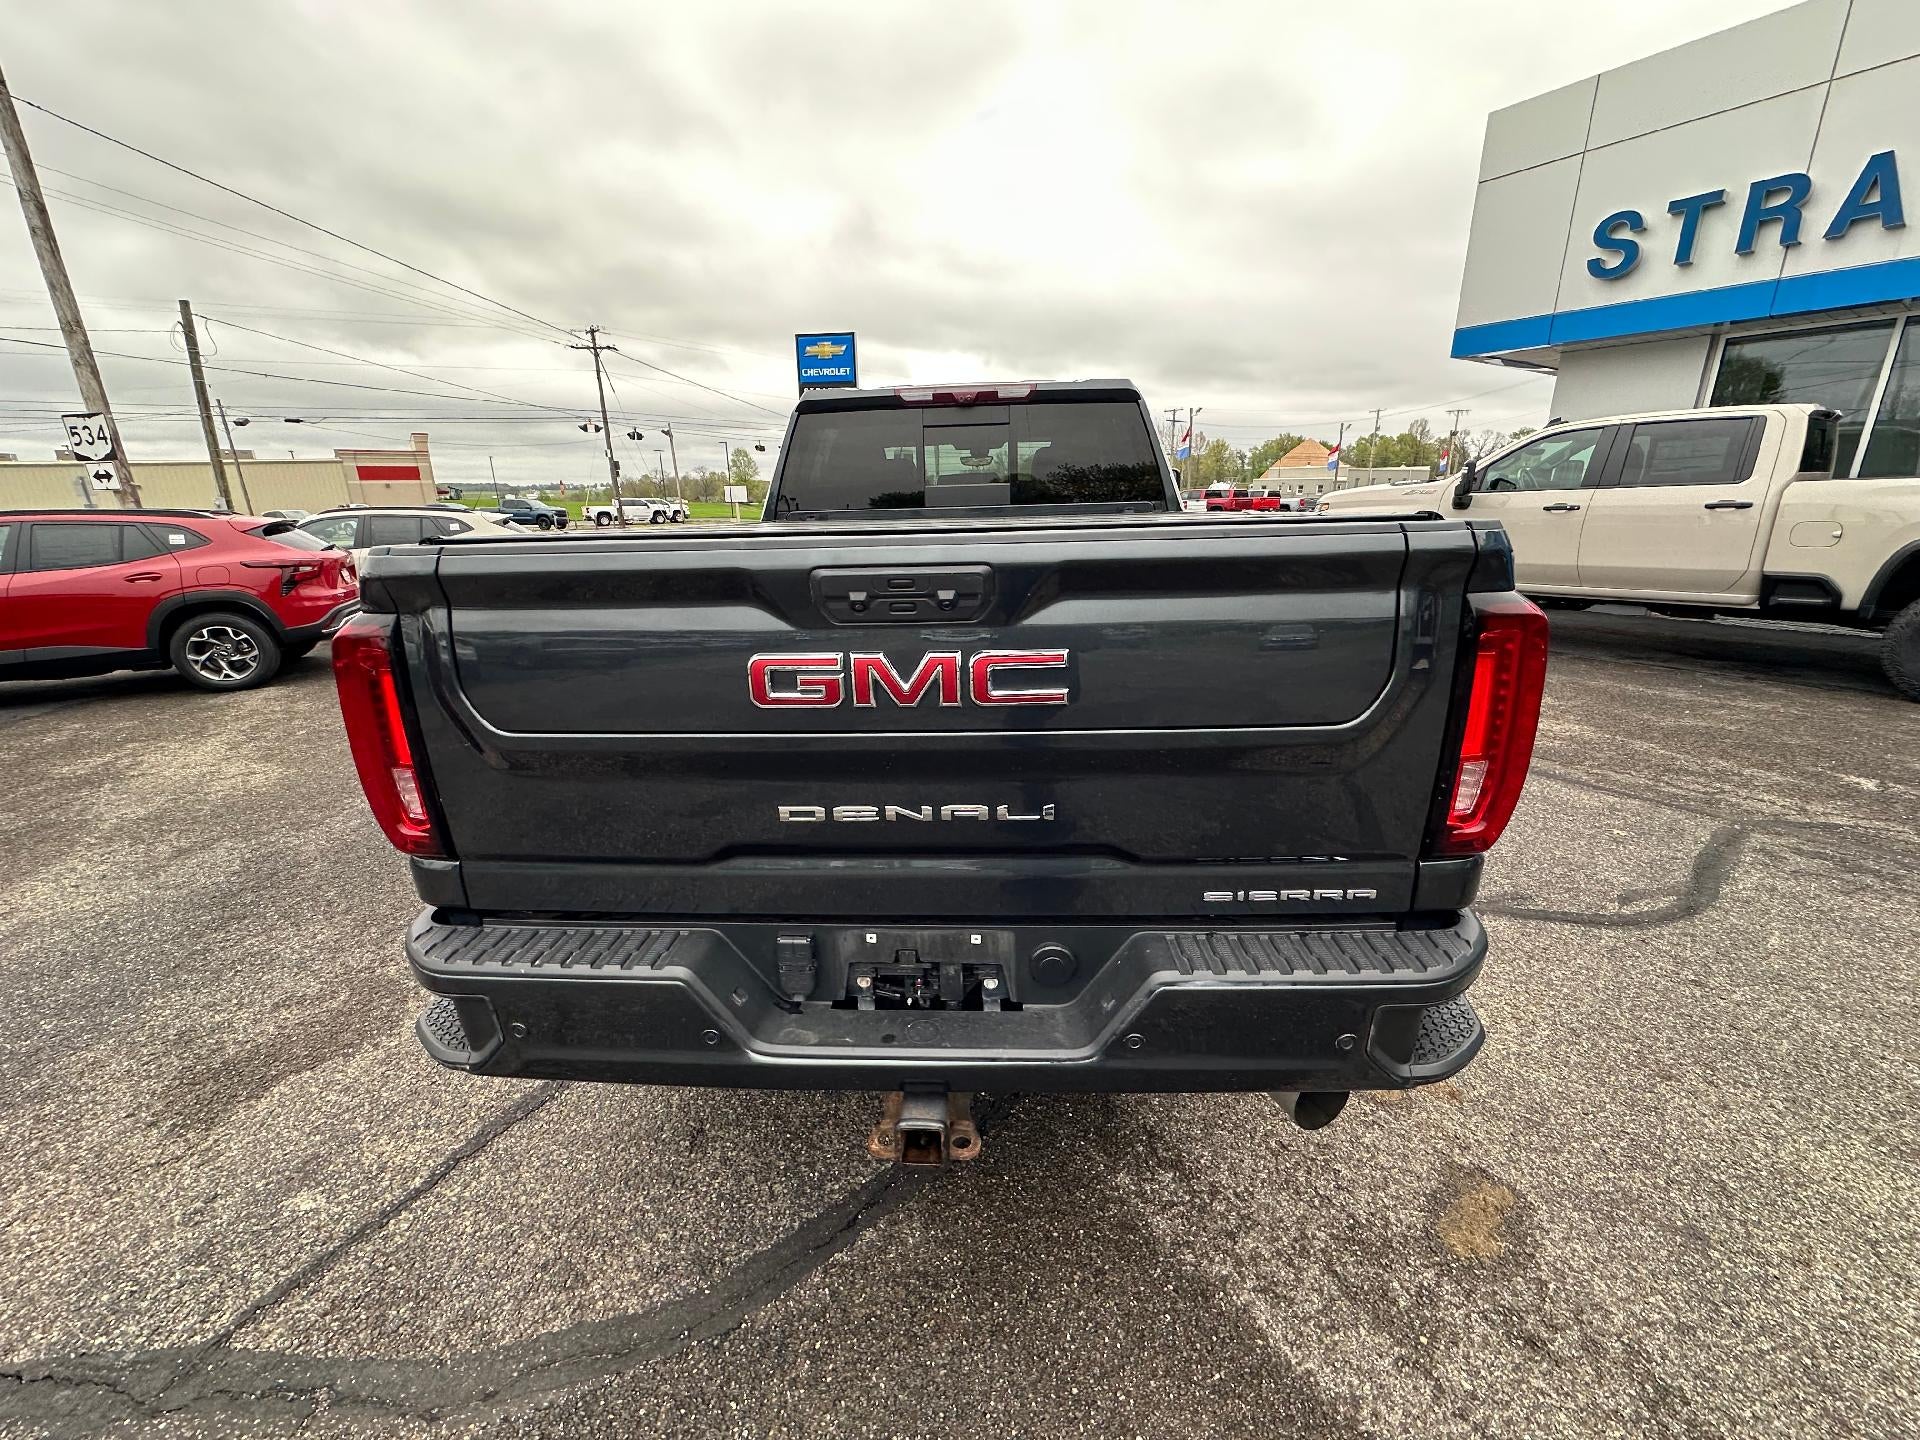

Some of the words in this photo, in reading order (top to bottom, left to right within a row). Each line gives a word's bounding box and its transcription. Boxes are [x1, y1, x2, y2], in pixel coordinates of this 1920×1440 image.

[1586, 149, 1906, 280] STRA
[801, 367, 851, 377] CHEVROLET
[69, 424, 109, 447] 534
[747, 648, 1070, 708] GMC
[778, 804, 1056, 822] DENALI
[1202, 889, 1378, 901] SIERRA
